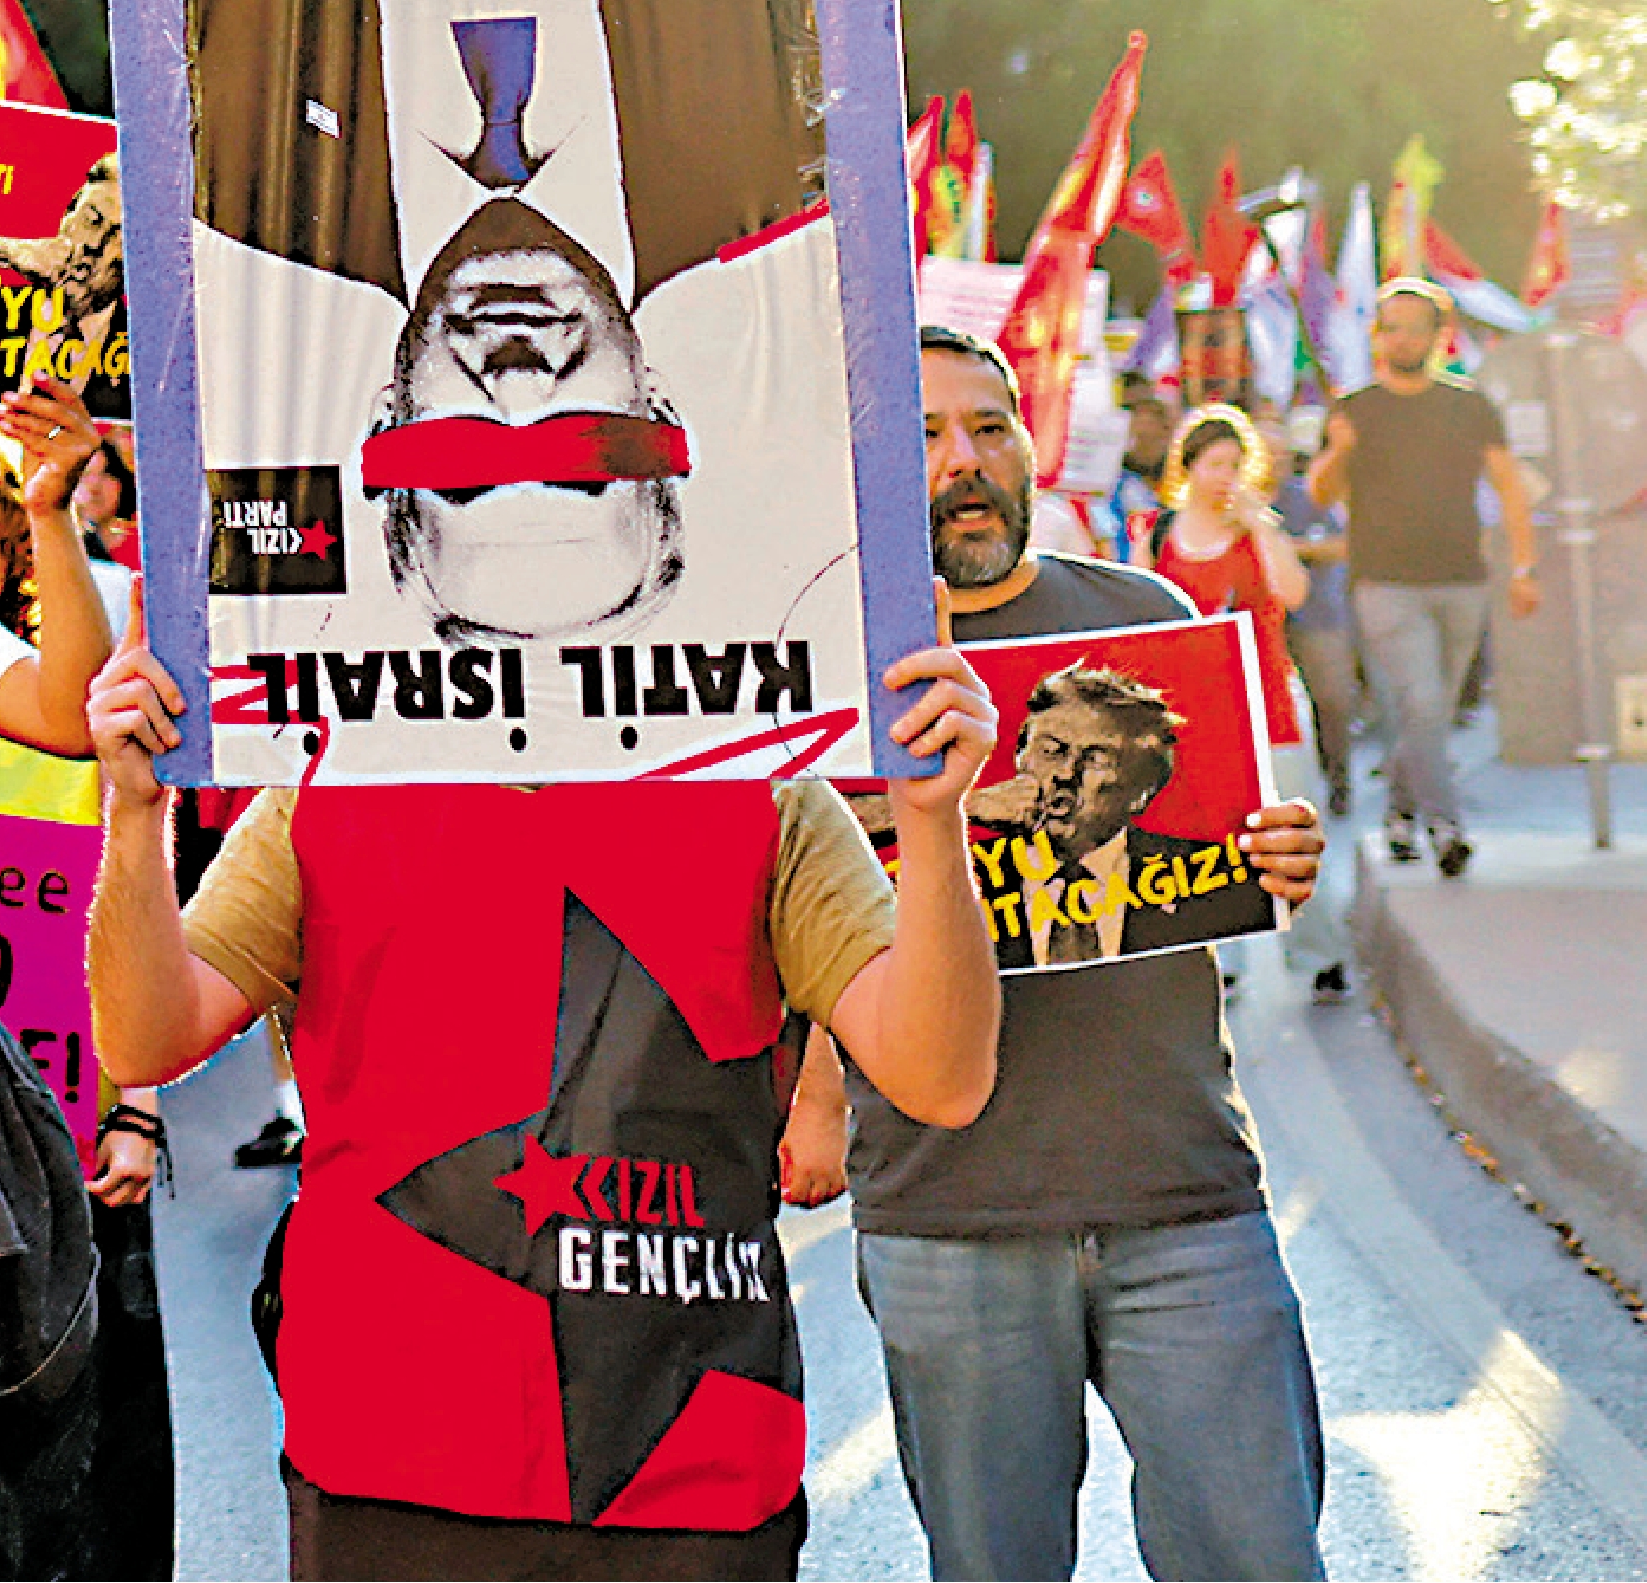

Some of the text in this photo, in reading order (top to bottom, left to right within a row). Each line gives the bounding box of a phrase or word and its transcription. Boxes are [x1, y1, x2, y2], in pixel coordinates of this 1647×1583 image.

[247, 639, 814, 757] KATİL İSRAİL
[558, 1224, 770, 1304] GENÇLİK
